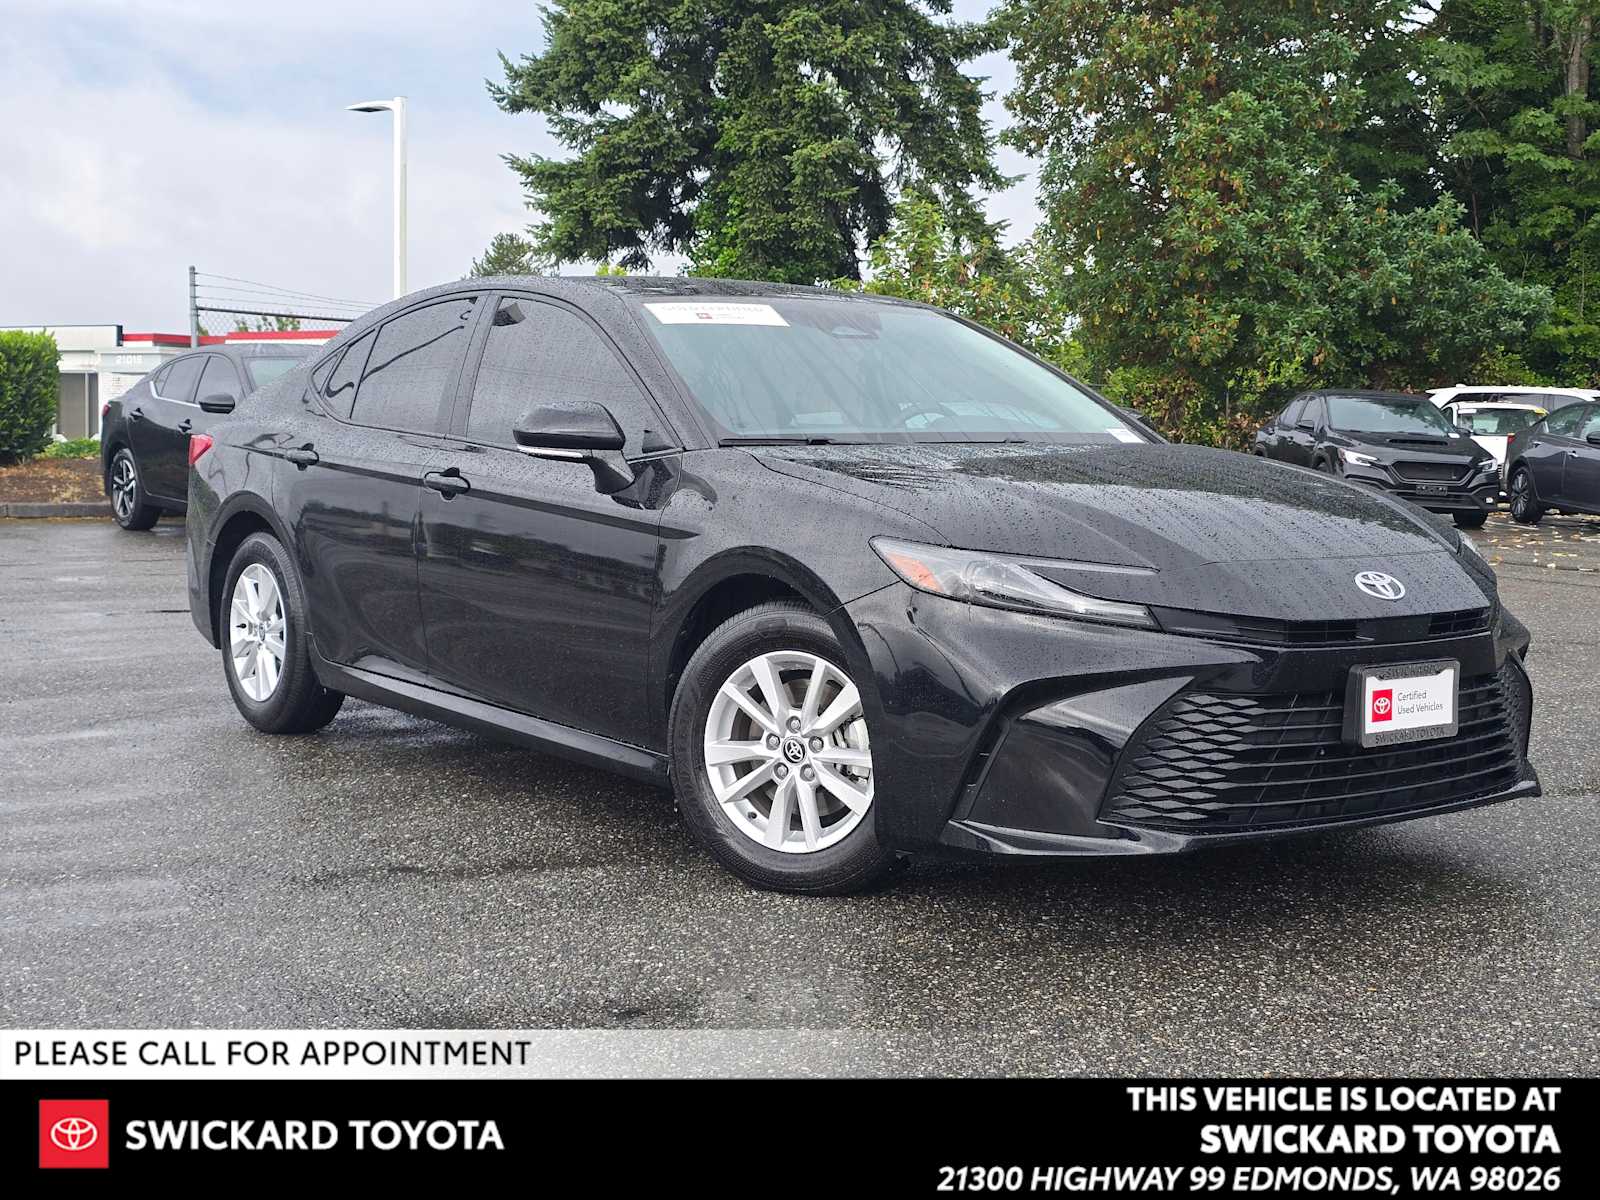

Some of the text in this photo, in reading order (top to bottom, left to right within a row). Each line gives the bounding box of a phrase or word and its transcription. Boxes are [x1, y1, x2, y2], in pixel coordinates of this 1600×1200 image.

[1397, 690, 1427, 702] Certified
[1397, 702, 1444, 715] Used Vehicles
